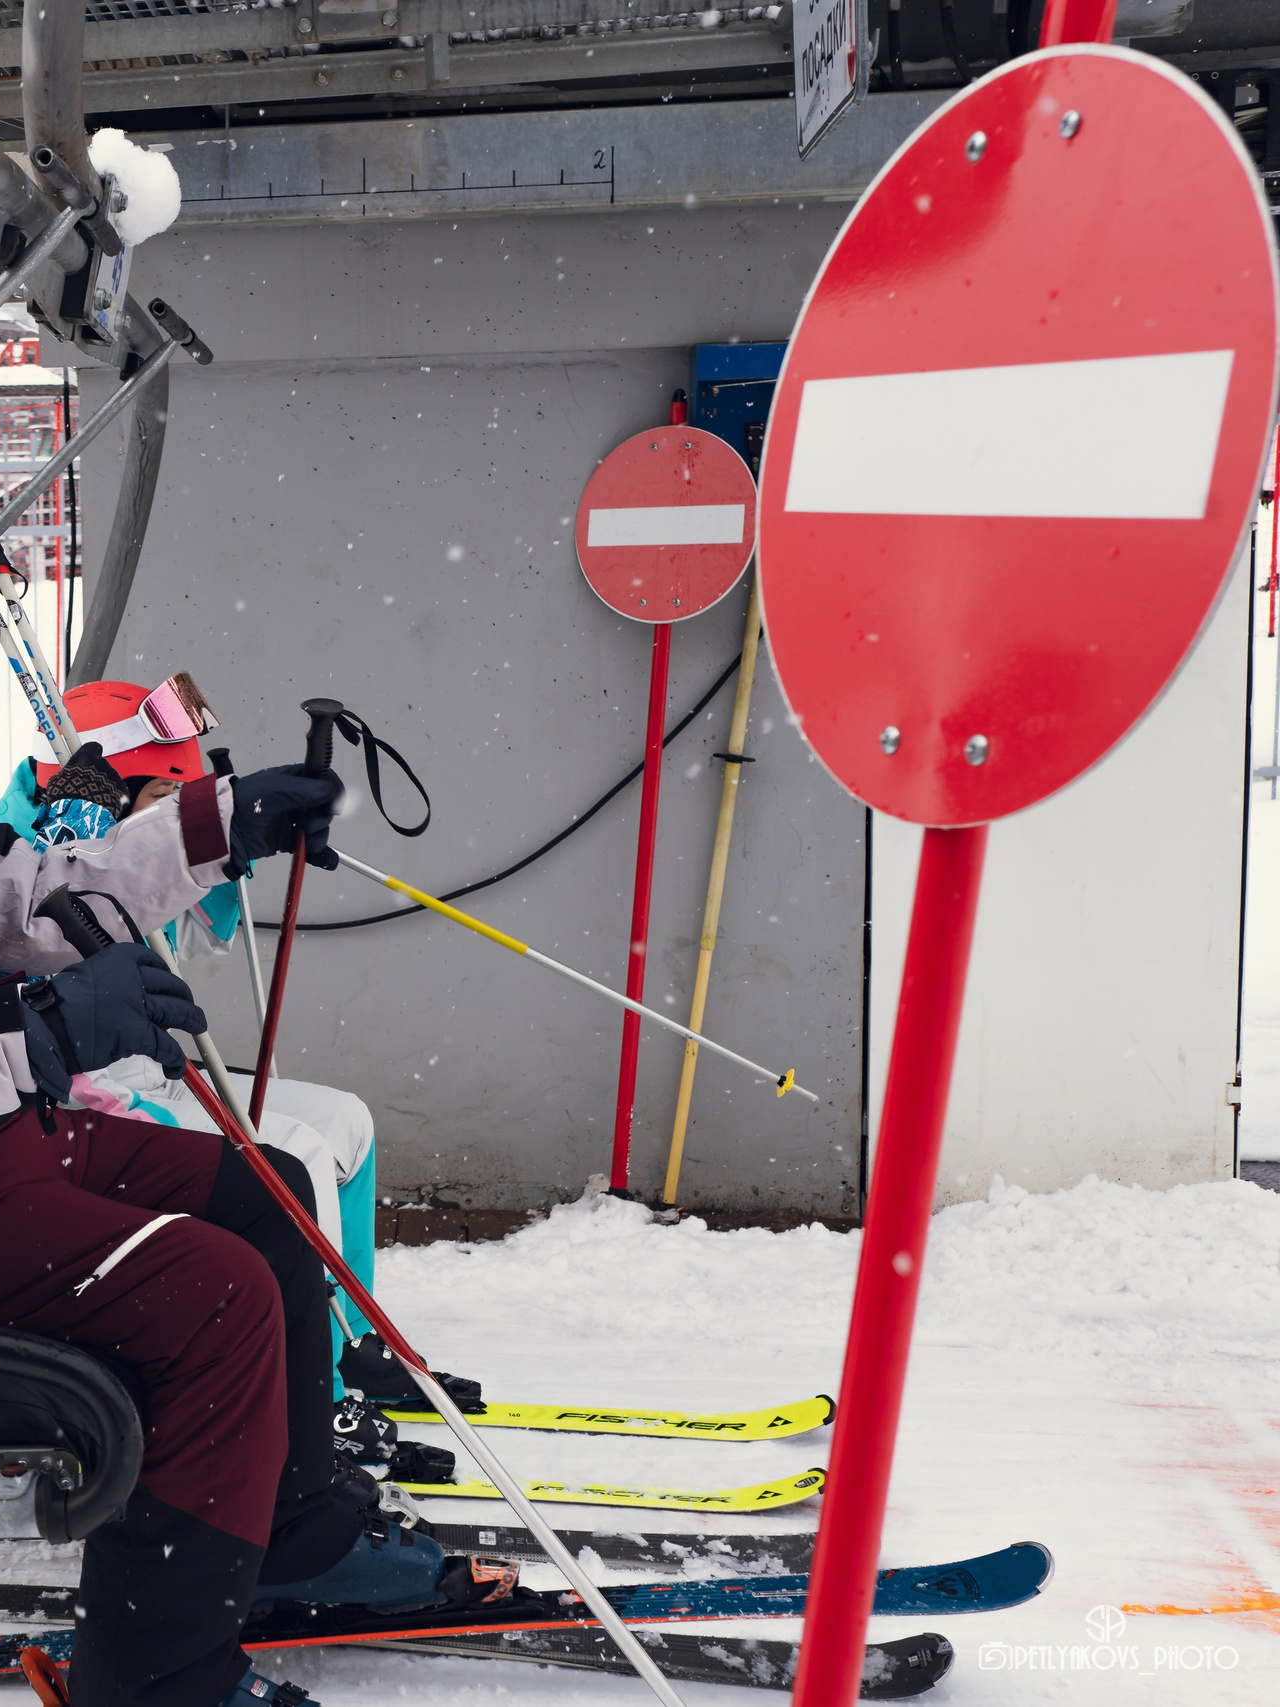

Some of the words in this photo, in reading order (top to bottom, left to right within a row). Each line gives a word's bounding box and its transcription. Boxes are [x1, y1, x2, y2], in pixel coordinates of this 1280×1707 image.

[802, 0, 846, 97] ПОСАДКИ
[593, 149, 606, 169] 2
[30, 698, 56, 742] OBER
